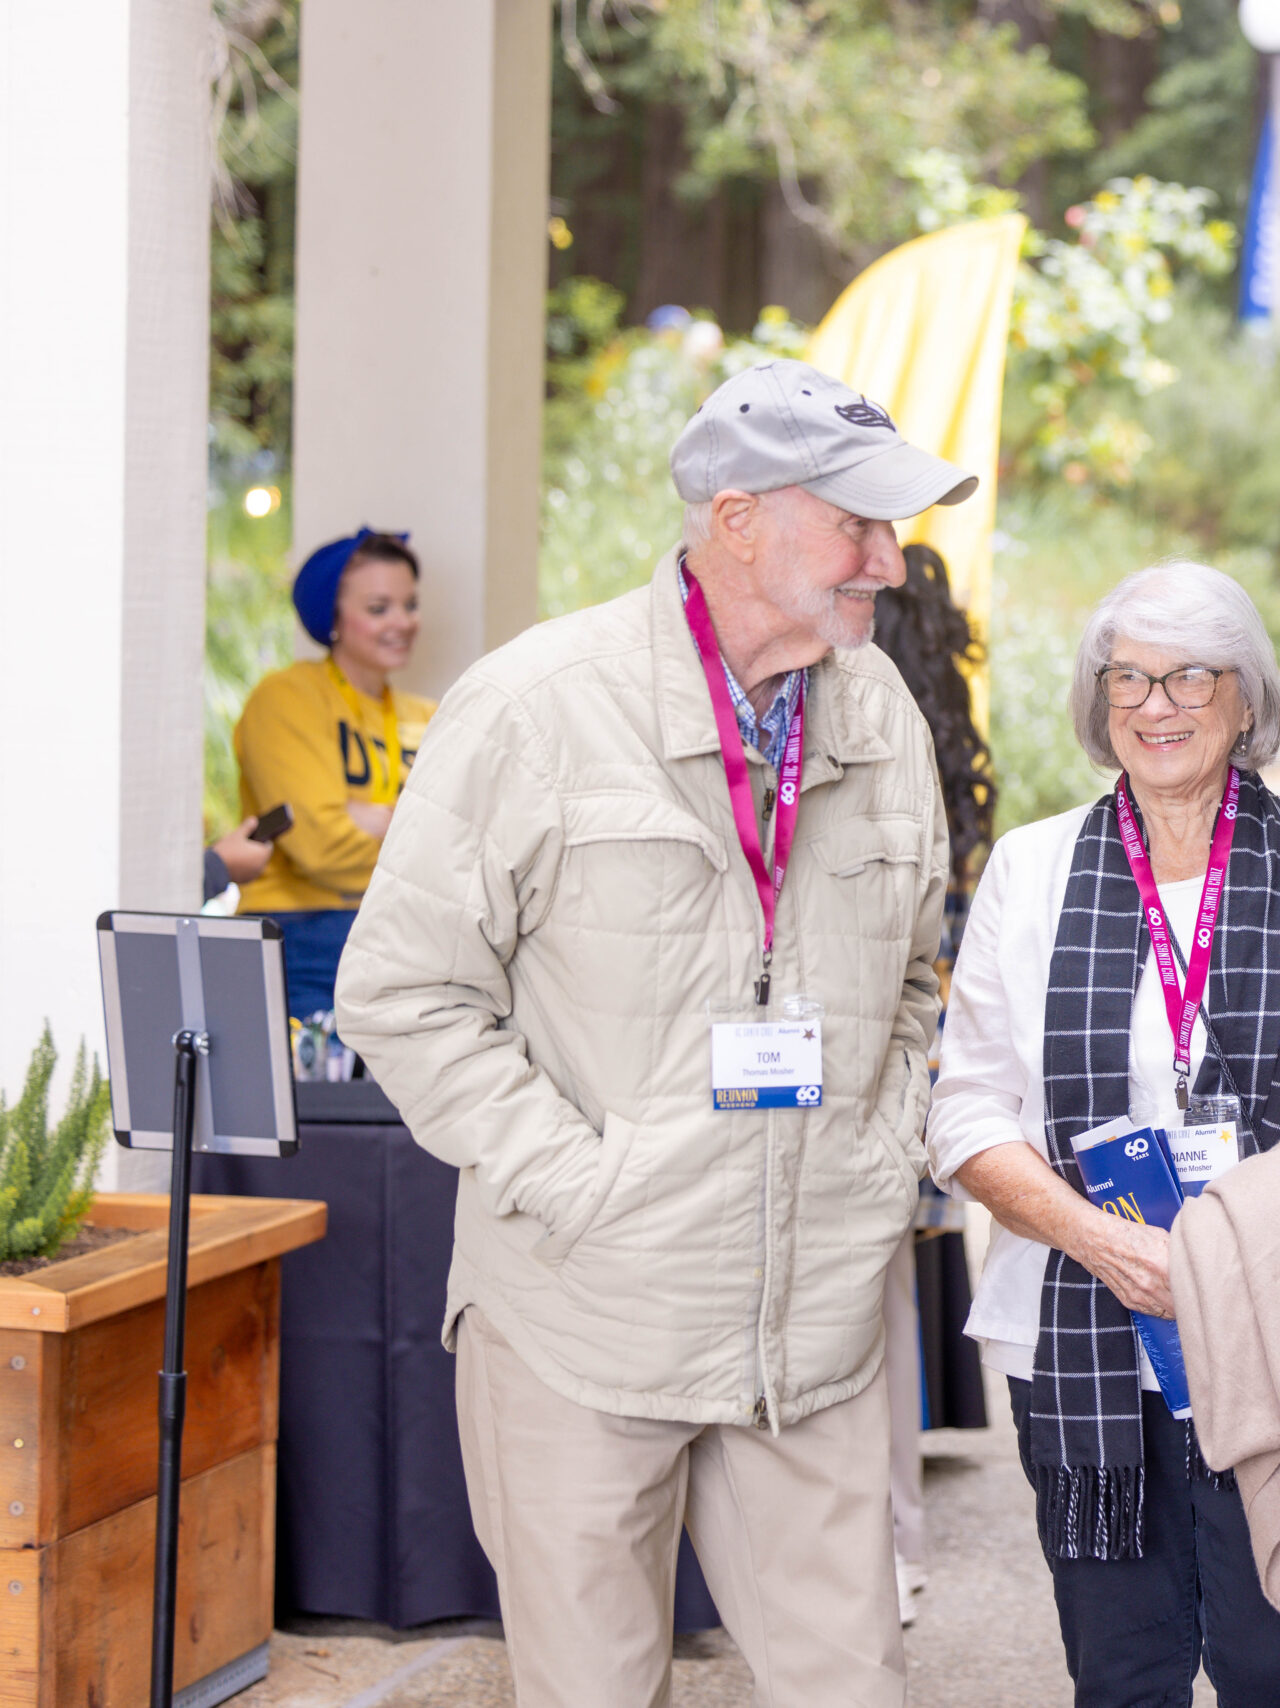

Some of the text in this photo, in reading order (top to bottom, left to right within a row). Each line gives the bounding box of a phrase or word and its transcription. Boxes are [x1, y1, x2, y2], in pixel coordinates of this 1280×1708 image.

[785, 737, 800, 763] SANTA
[783, 765, 798, 777] UC
[781, 782, 796, 805] 60
[1224, 803, 1238, 820] 60
[1121, 819, 1138, 842] SANTA
[1127, 841, 1144, 860] CRUZ
[1197, 867, 1223, 949] 60 UC SANTA CRUZ
[1148, 907, 1176, 986] 60 UC SANTA CRUZ
[1183, 1000, 1197, 1021] CRUZ
[757, 1051, 781, 1064] TOM
[716, 1088, 758, 1103] REUNION
[796, 1085, 820, 1101] 60
[1195, 1128, 1217, 1136] Alumni
[1124, 1138, 1149, 1157] 60
[1132, 1151, 1150, 1161] YEARS
